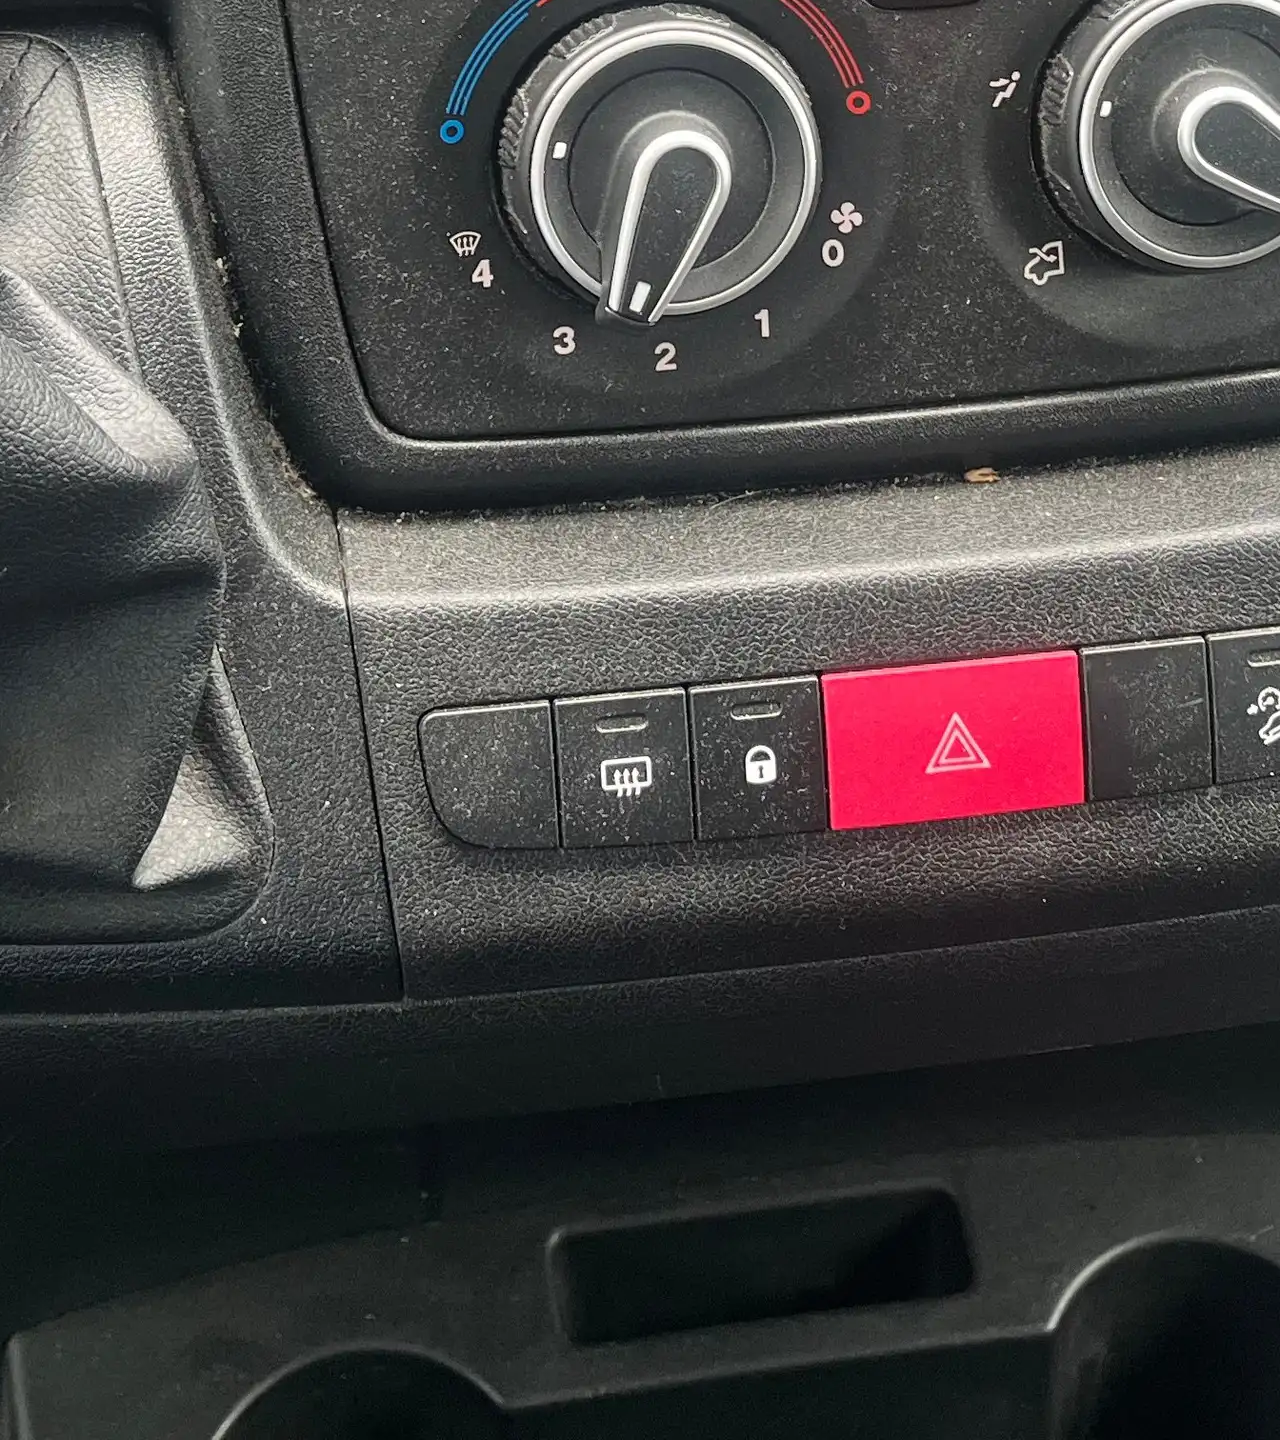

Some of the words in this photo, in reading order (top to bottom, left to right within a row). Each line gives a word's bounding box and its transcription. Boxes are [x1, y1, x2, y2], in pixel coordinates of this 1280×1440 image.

[821, 239, 846, 268] 0
[471, 258, 494, 288] 4
[753, 308, 771, 338] 1
[552, 326, 577, 355] 3
[654, 342, 678, 372] 2
